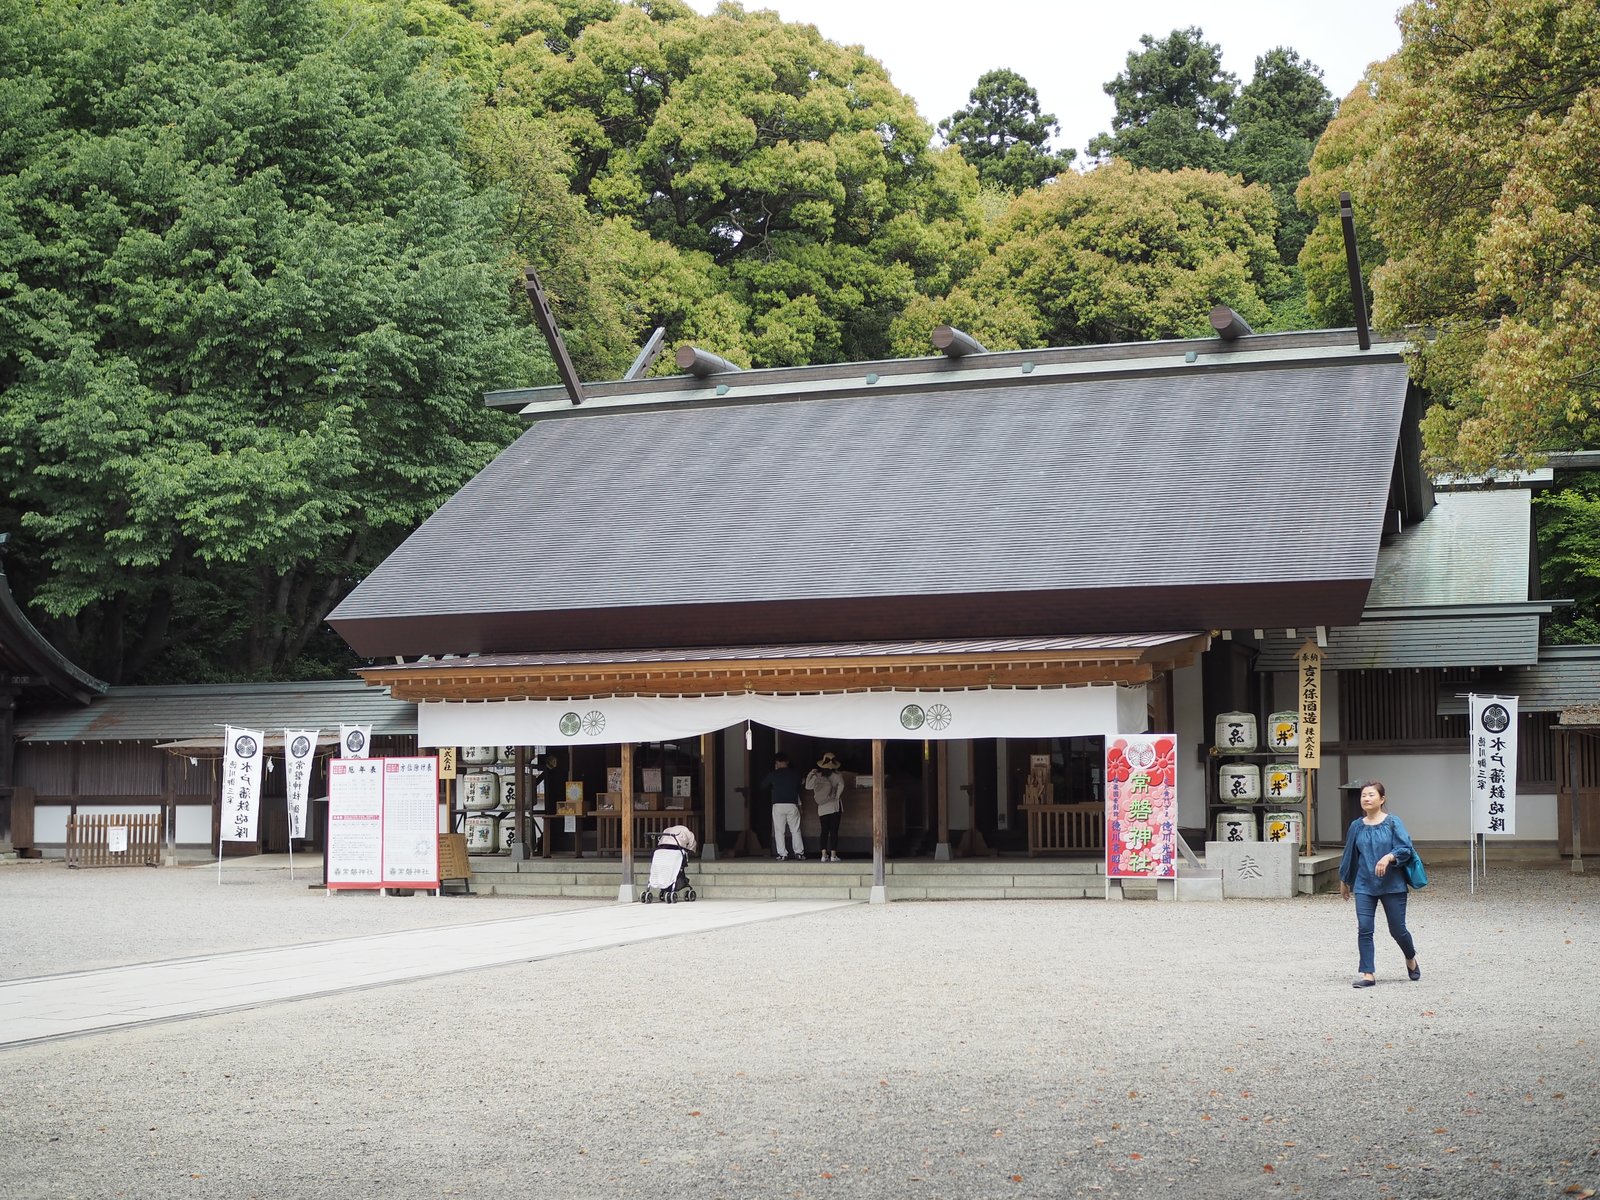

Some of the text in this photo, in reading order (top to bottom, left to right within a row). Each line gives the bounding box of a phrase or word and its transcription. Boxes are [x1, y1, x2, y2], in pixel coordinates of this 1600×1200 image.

[1302, 653, 1318, 661] 奉納
[1302, 665, 1318, 759] 吉久保酒造 株式会社
[1228, 723, 1245, 746] 一品
[348, 765, 377, 774] 厄年表
[400, 763, 433, 772] 方位除け表
[1230, 774, 1247, 798] 一品
[1128, 773, 1153, 873] 常磐神社
[1227, 821, 1244, 842] 一品
[1237, 855, 1262, 880] 奉
